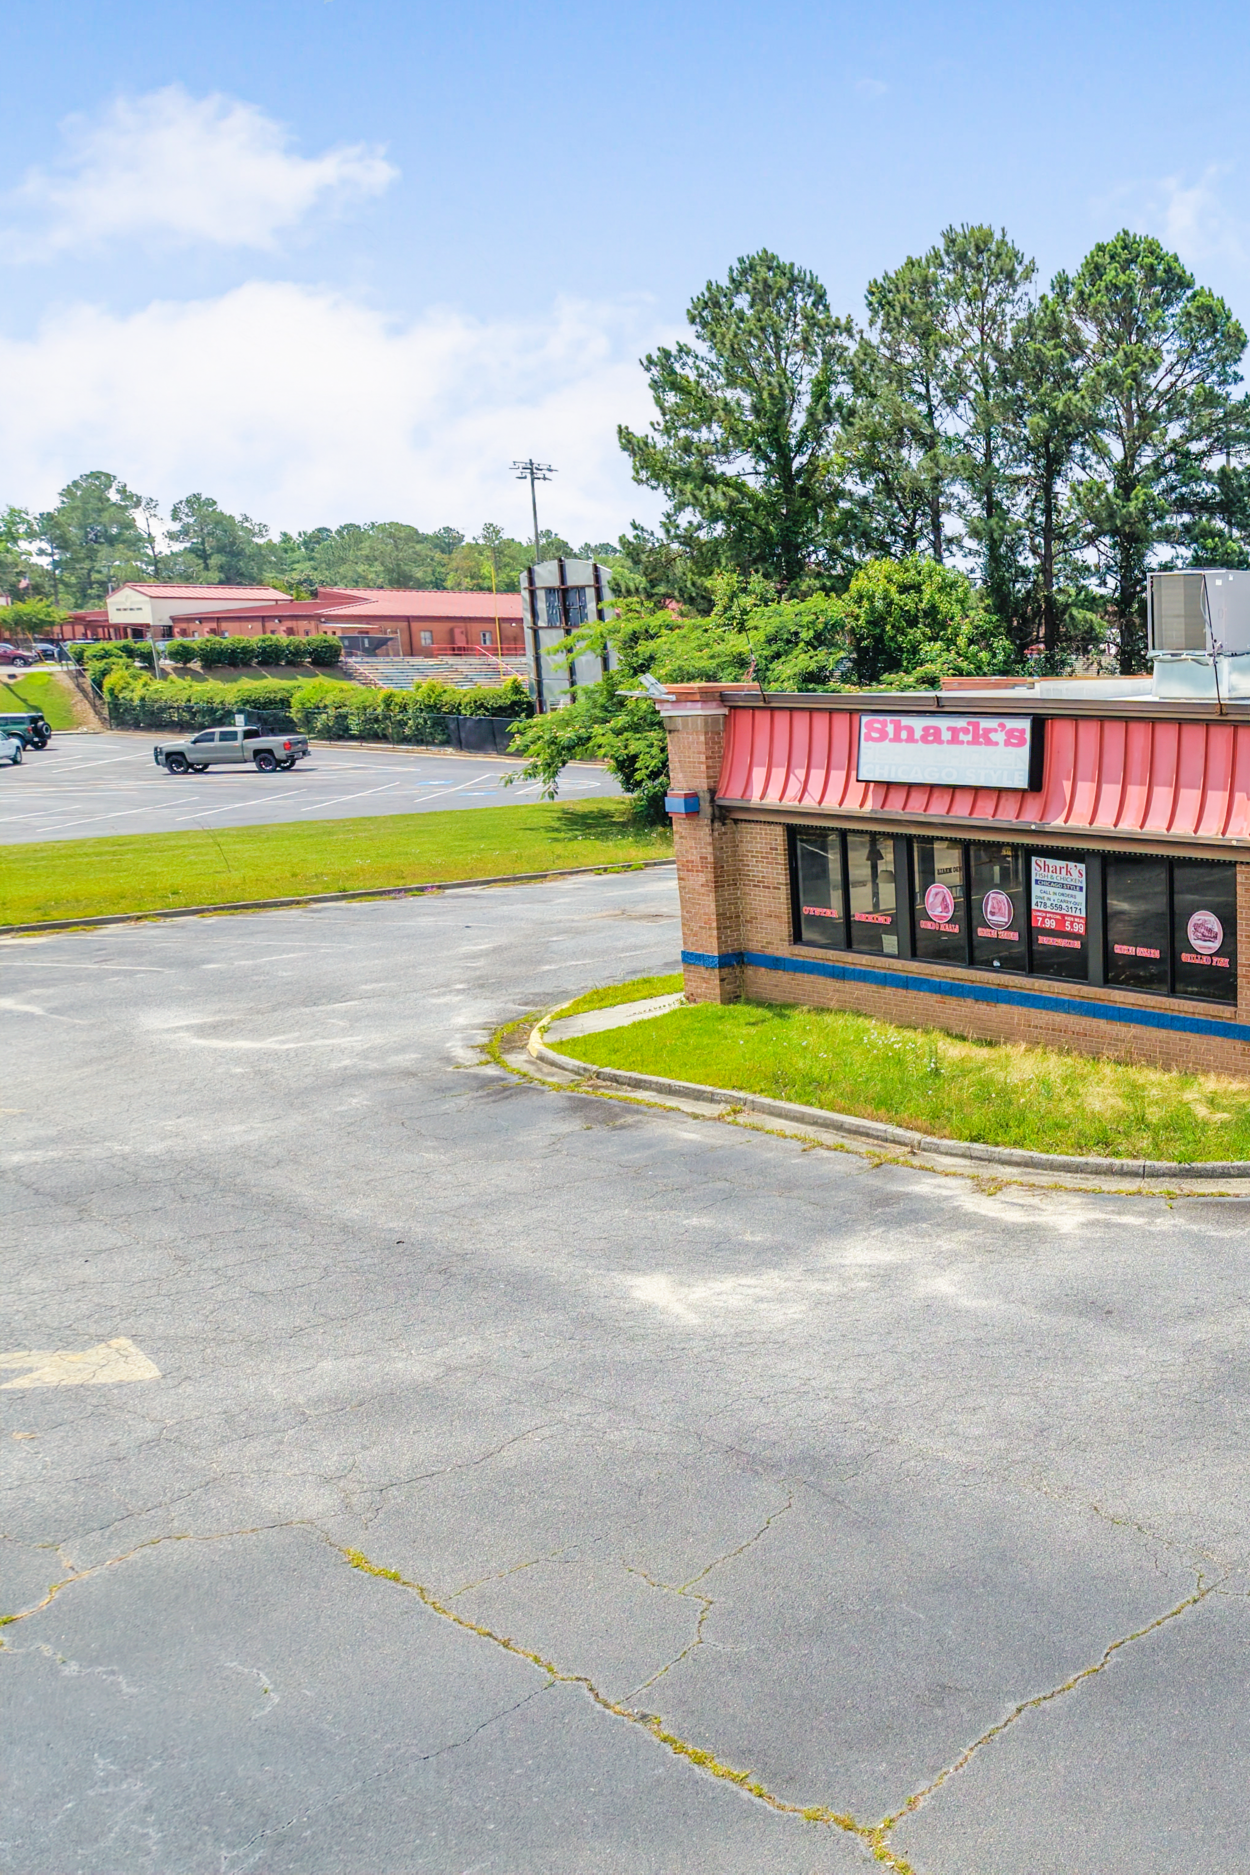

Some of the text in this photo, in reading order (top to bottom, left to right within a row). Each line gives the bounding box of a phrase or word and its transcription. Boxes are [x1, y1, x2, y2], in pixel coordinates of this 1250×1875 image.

[863, 718, 1028, 748] Shark's
[862, 763, 1025, 785] CHICAGO STYLE
[1034, 859, 1083, 878] Shark's
[1038, 880, 1062, 888] CHICAGO
[1056, 875, 1082, 884] CHICKEN
[803, 906, 838, 918] OYSTER
[1034, 900, 1082, 915] 478-559-3171
[1037, 917, 1056, 928] 7.99
[1065, 921, 1084, 933] 5.99
